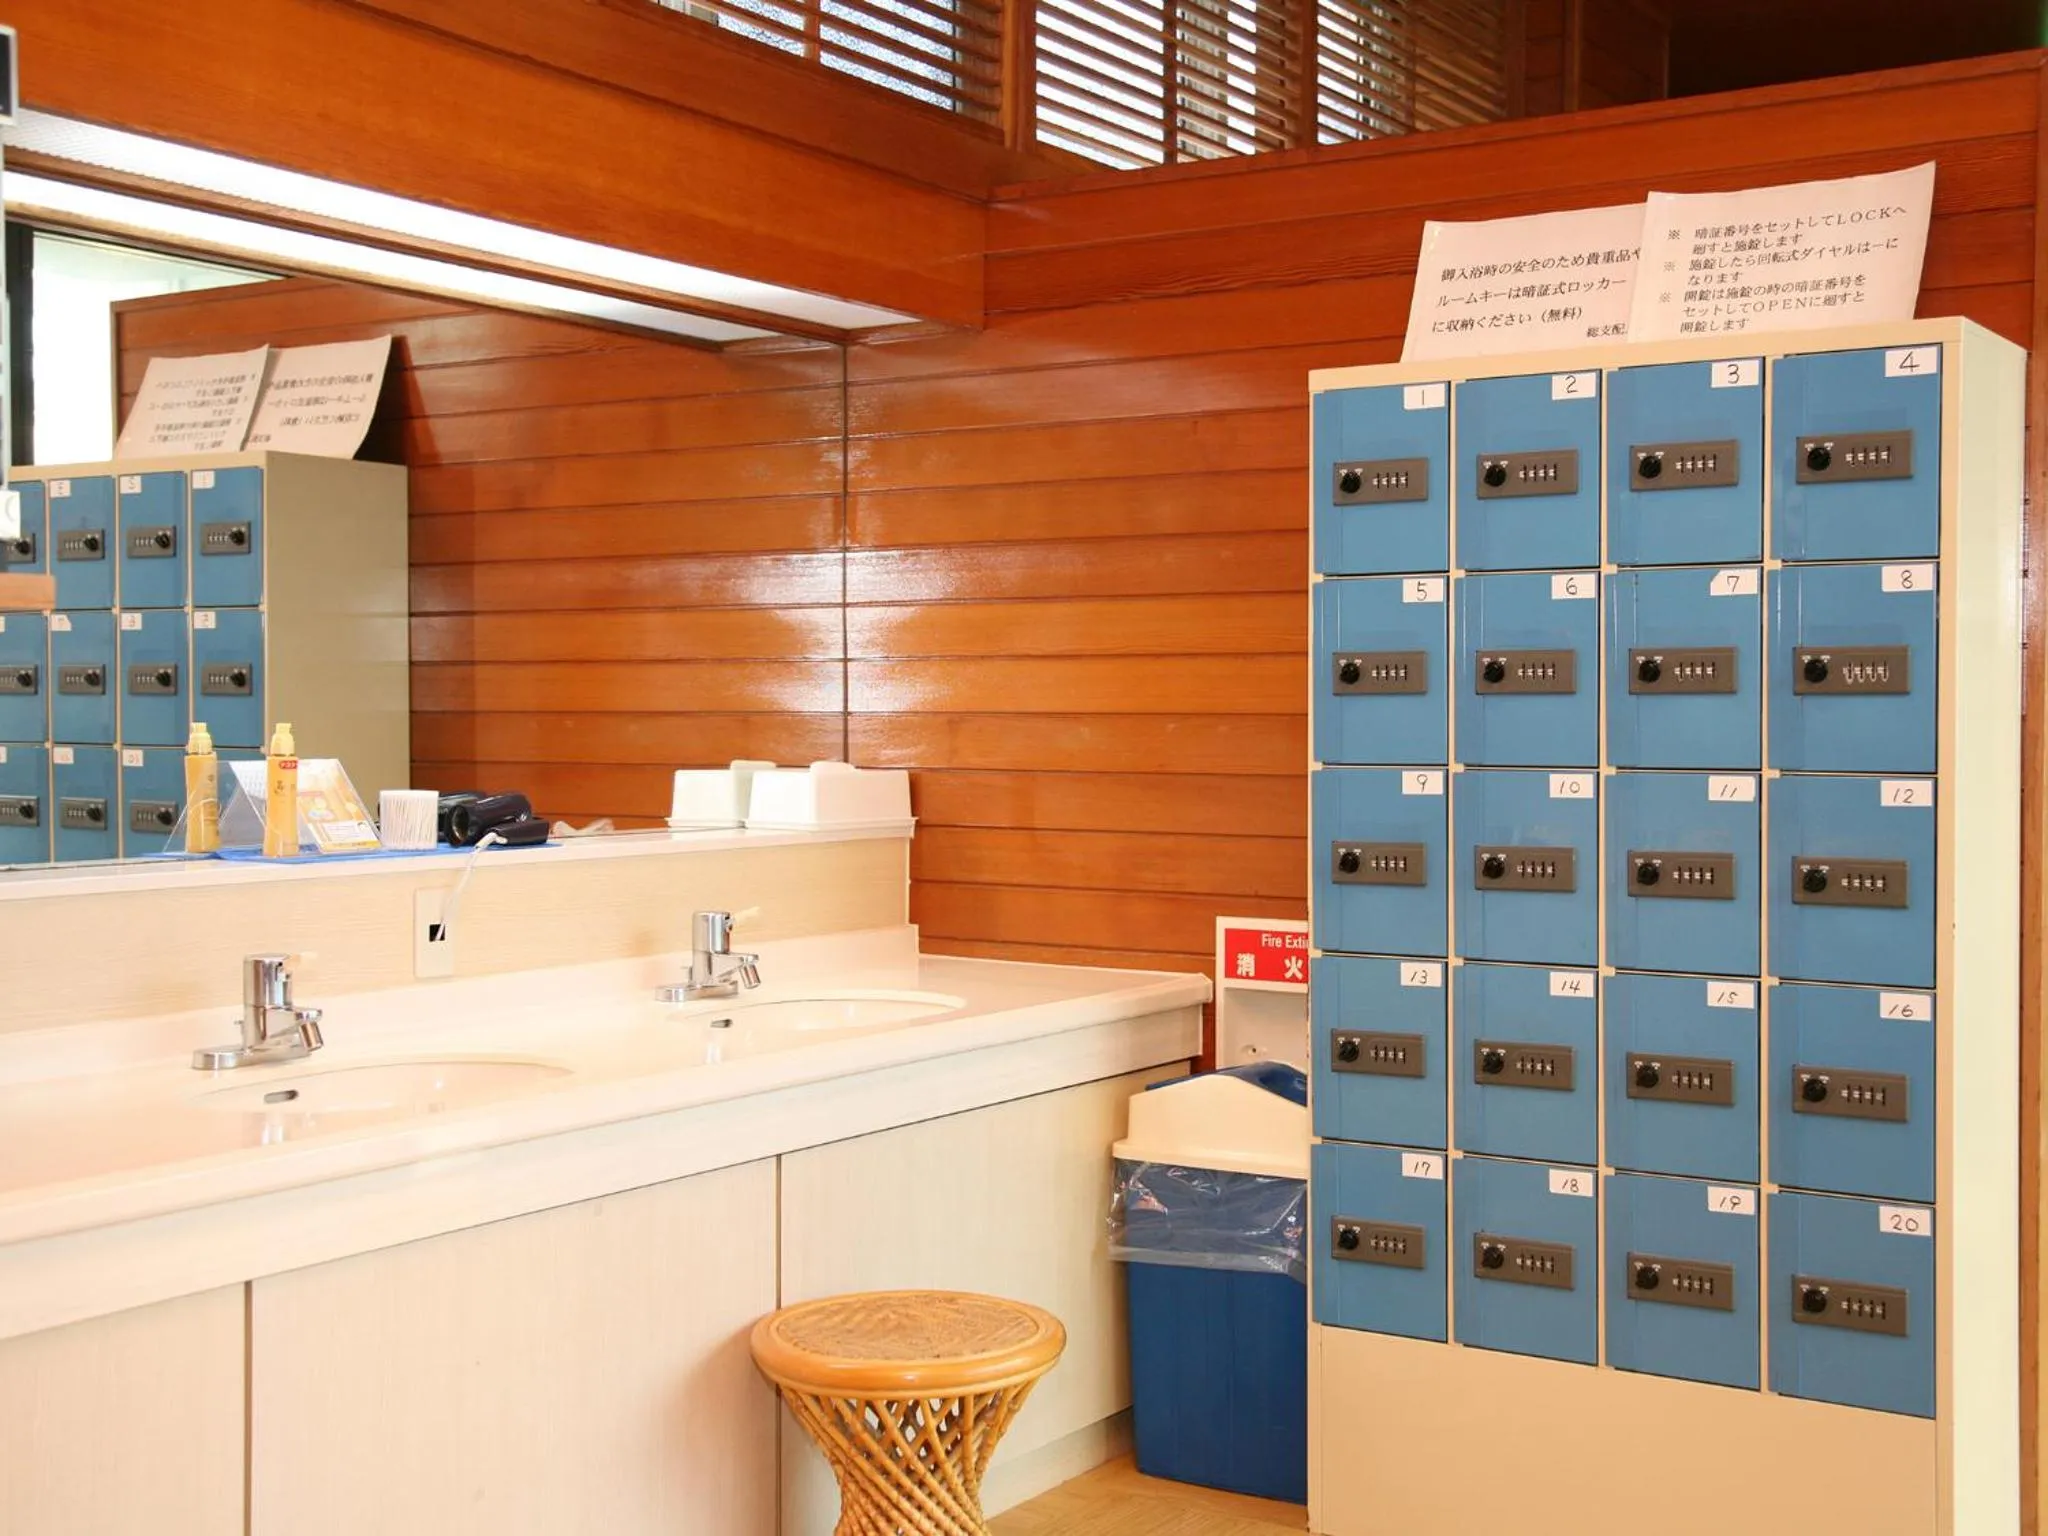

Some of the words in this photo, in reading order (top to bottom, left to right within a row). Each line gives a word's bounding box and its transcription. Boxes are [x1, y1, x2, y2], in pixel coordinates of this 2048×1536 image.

[1687, 271, 1743, 287] なります
[1436, 276, 1627, 308] ルームキーは暗証式ロッカー
[1586, 322, 1628, 338] 総支配
[1679, 317, 1750, 334] 開錠します
[1898, 351, 1920, 373] 4
[1727, 363, 1740, 383] 3
[1565, 376, 1579, 394] 2
[1420, 389, 1426, 406] 1
[1565, 577, 1578, 595] 6
[1726, 575, 1740, 592] 7
[1900, 569, 1913, 588] 8
[1416, 580, 1428, 600] 5
[1416, 773, 1428, 791] 9
[1559, 781, 1581, 794] 10
[1720, 783, 1738, 798] 11
[1893, 788, 1914, 803] 12
[1261, 933, 1281, 948] Fire
[1410, 969, 1428, 984] 13
[1561, 980, 1581, 994] 14
[1717, 991, 1738, 1003] 15
[1888, 1004, 1914, 1017] 16
[1414, 1161, 1431, 1176] 17
[1561, 1178, 1579, 1193] 18
[1719, 1195, 1742, 1211] 19
[1890, 1213, 1919, 1232] 20
